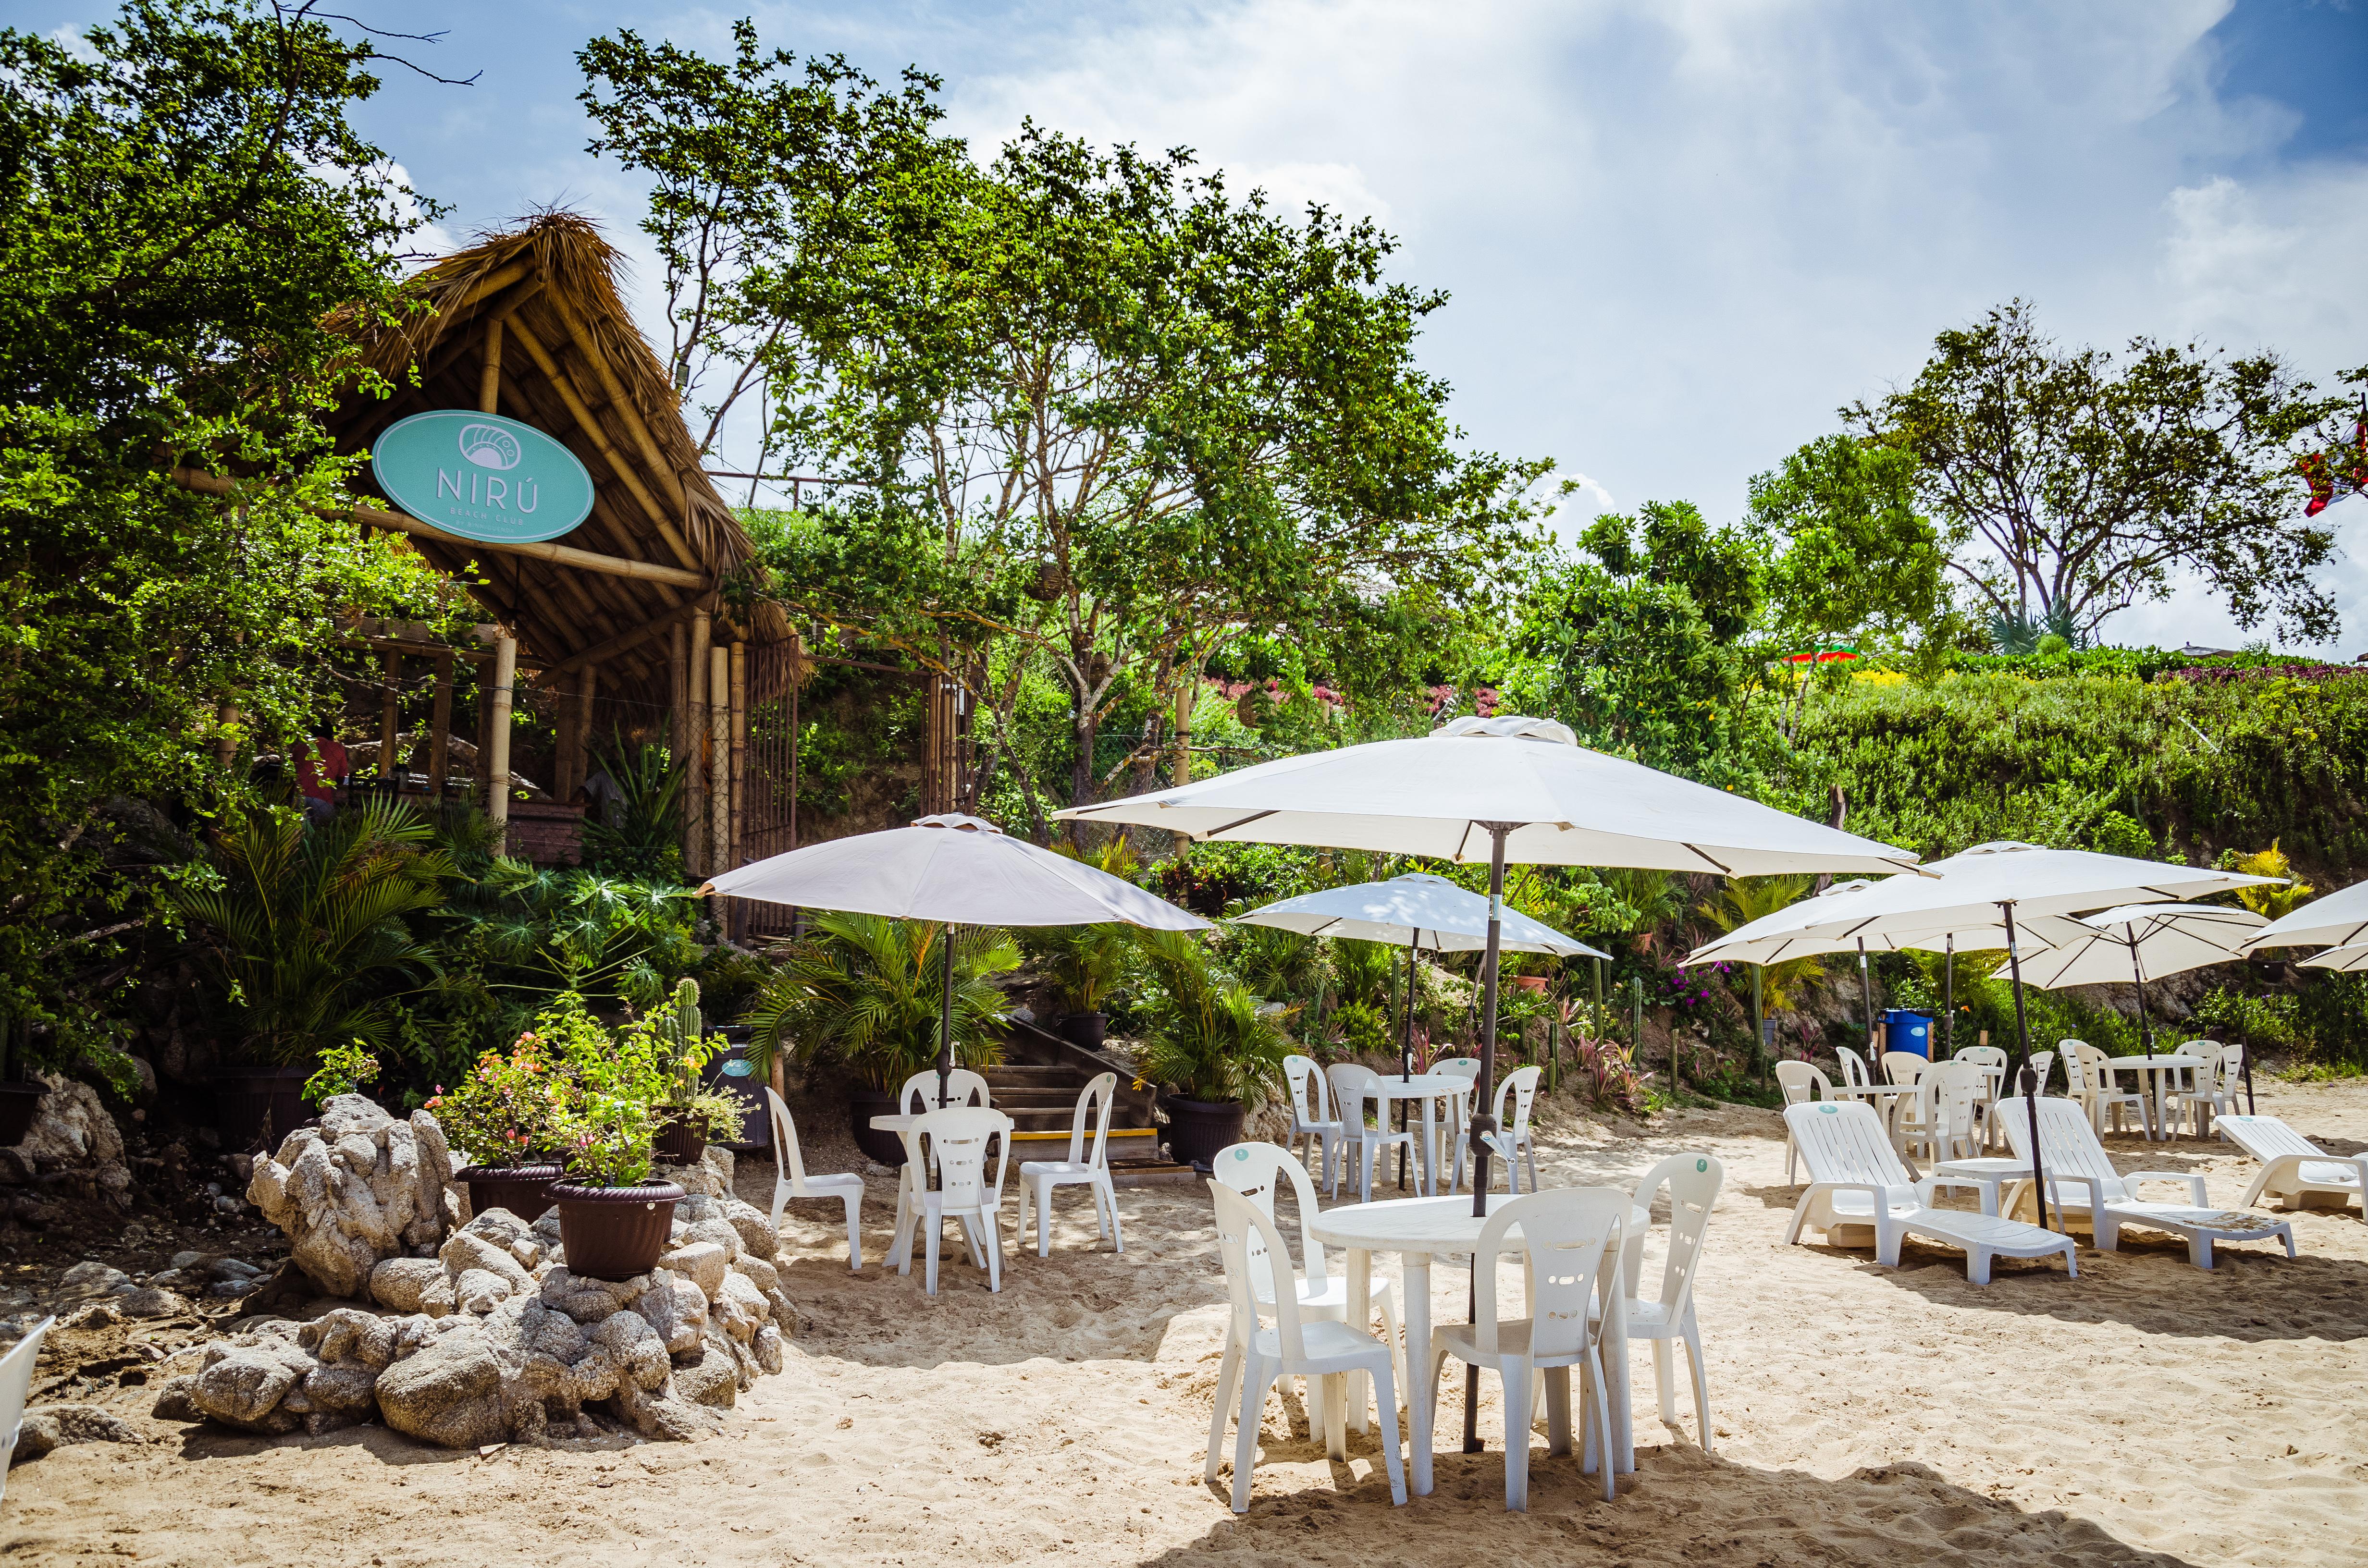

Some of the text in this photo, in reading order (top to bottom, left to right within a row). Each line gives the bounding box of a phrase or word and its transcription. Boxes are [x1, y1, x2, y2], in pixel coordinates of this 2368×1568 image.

[437, 467, 538, 514] NIRÚ
[450, 507, 523, 526] BEACH CLUB
